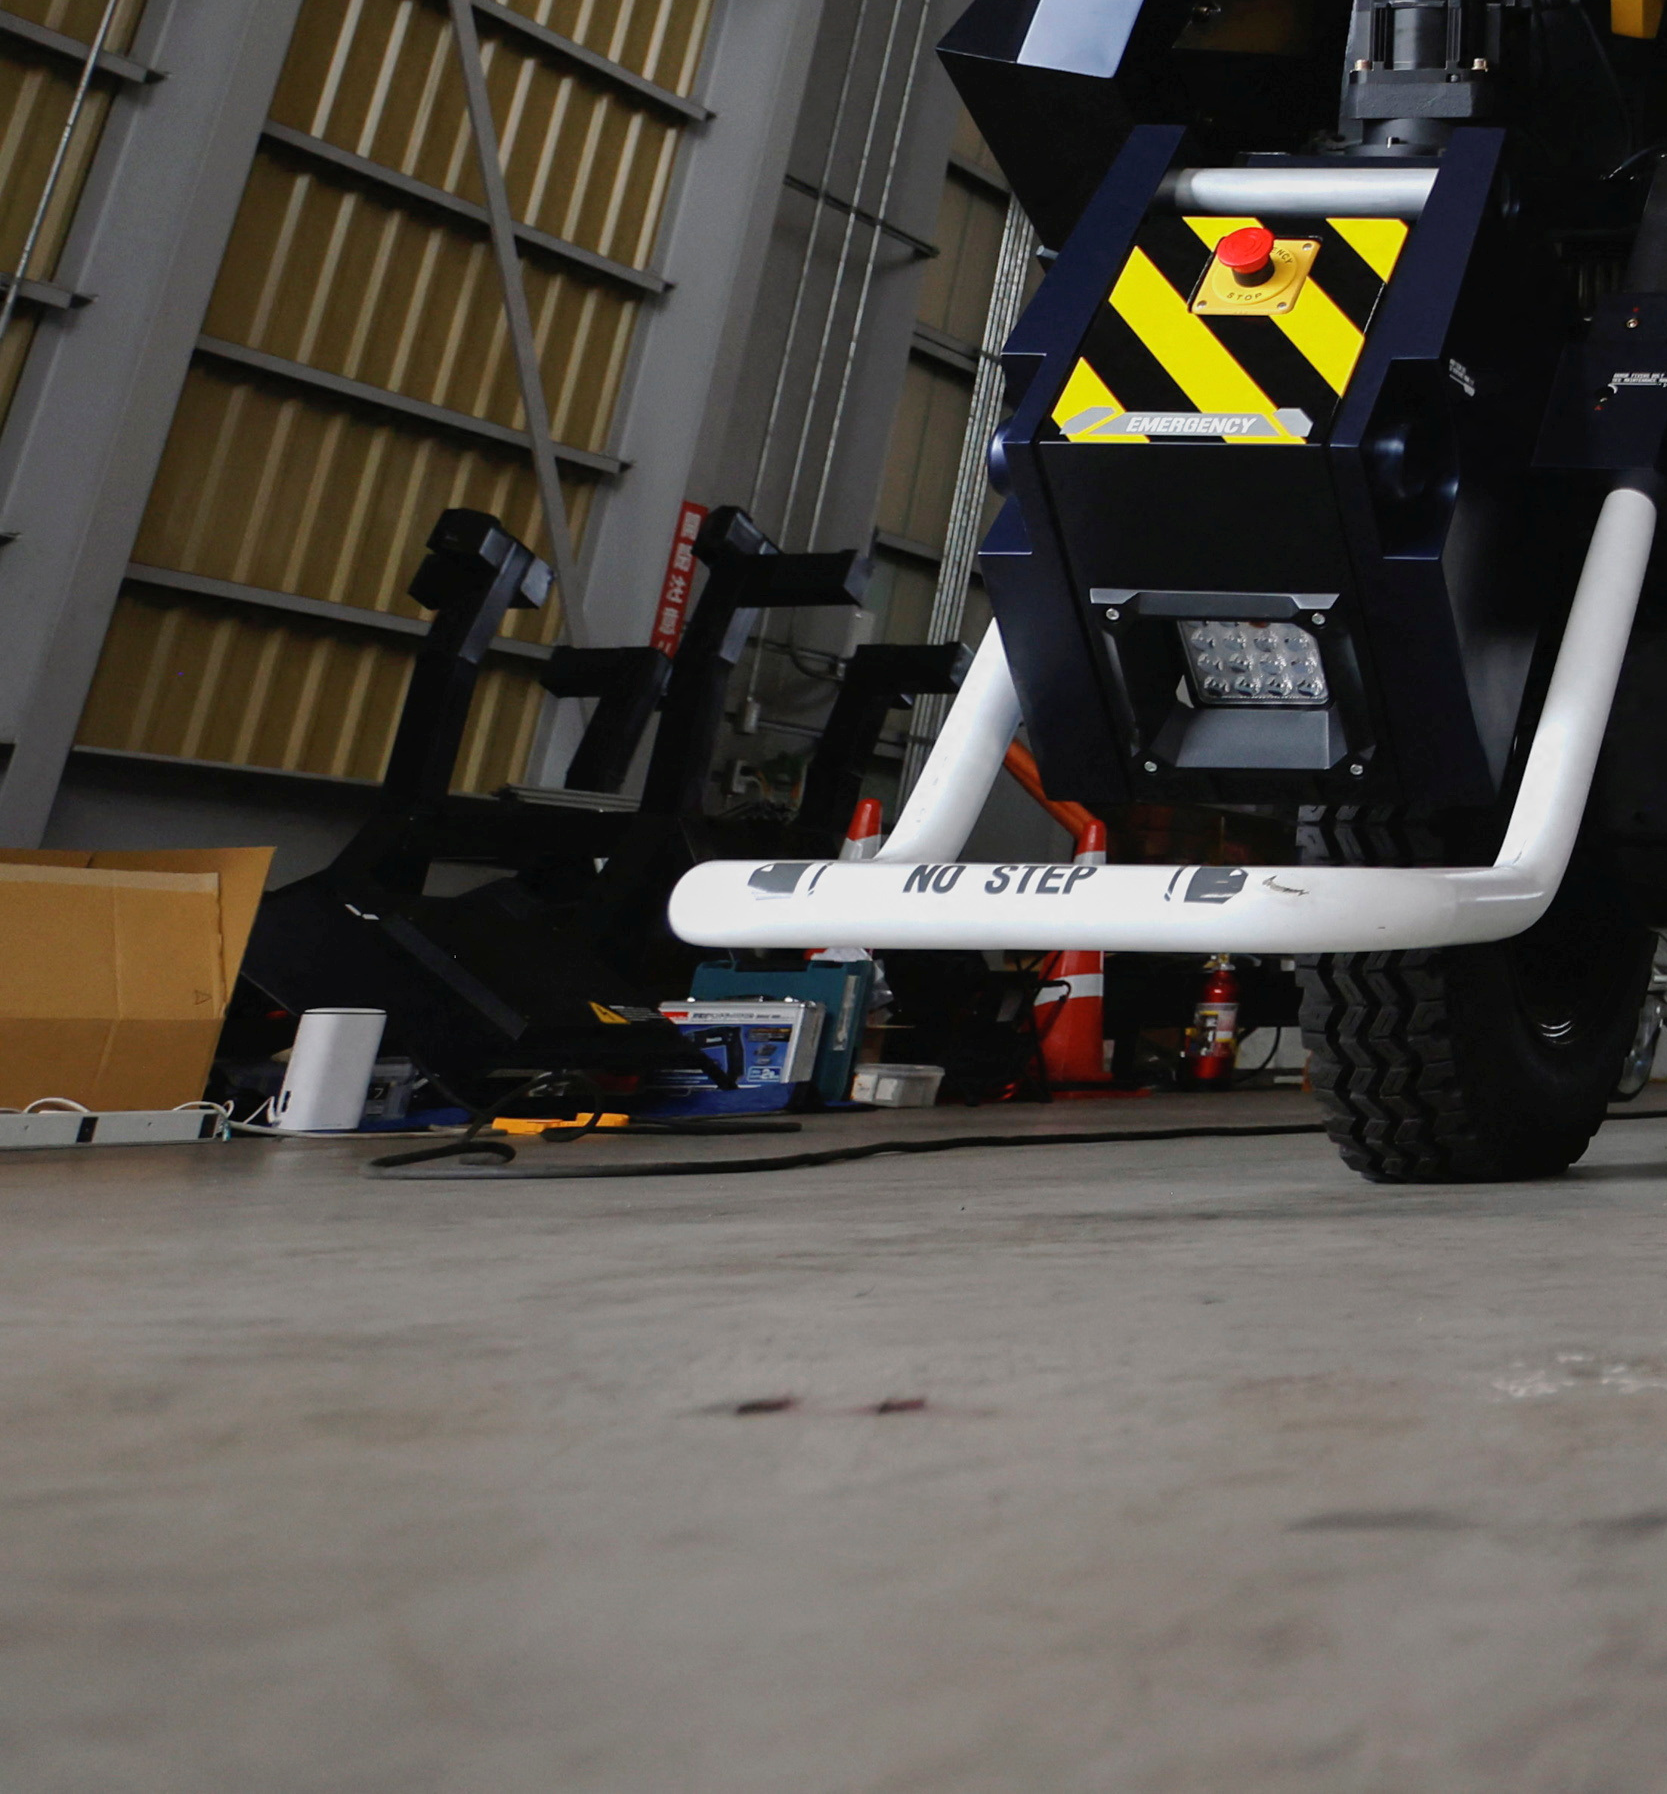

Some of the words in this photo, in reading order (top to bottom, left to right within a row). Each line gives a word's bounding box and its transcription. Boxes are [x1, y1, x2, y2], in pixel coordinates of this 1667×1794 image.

[1227, 292, 1262, 301] STOP
[1126, 416, 1256, 433] EMERGENCY
[902, 865, 966, 893] NO
[984, 865, 1098, 894] STEP
